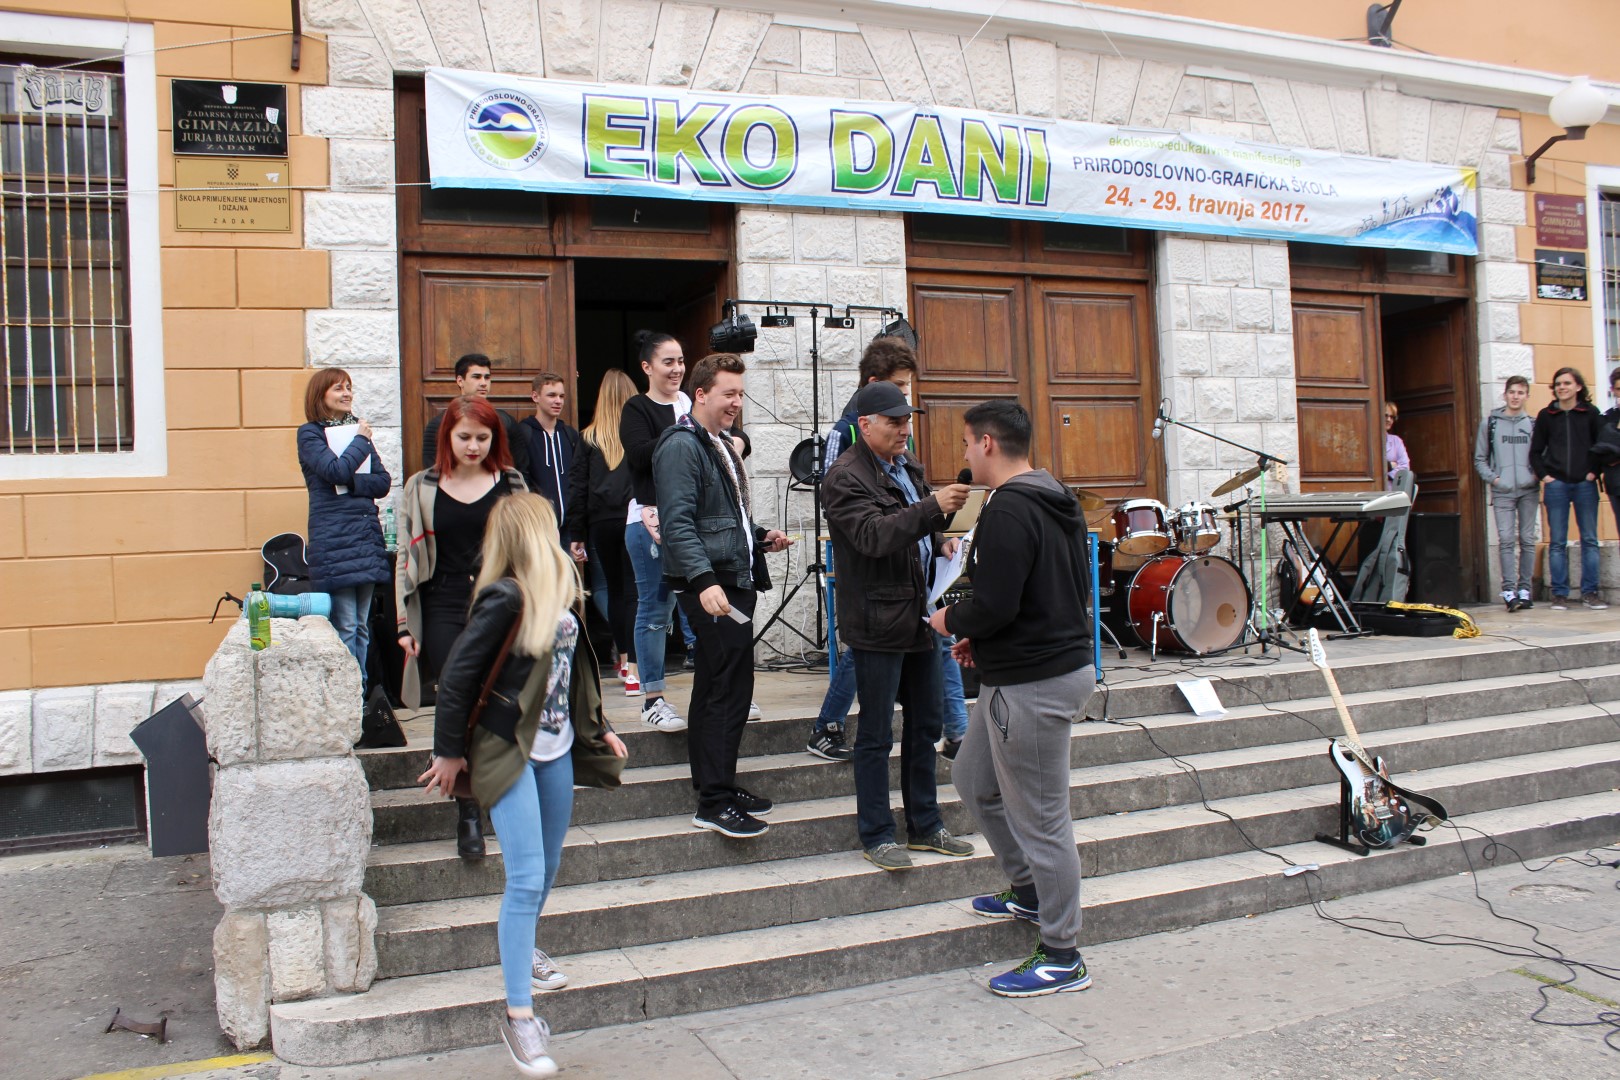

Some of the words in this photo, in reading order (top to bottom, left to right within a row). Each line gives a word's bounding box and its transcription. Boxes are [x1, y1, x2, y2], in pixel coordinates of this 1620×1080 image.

[187, 110, 231, 118] ZADARSKA
[178, 118, 282, 133] GIMNAZIJA
[182, 132, 212, 142] JURJA
[215, 133, 279, 144] BARAKOVIĆA
[582, 93, 799, 190] EKO
[829, 108, 1051, 206] DANI
[1232, 149, 1302, 168] manifestacija
[1072, 156, 1290, 192] PRIRODOSLOVNO-GRAFIČKA
[1291, 176, 1339, 197] ŠKOLA
[179, 193, 201, 202] ŠKOLA
[202, 195, 247, 203] PRIMIJENJENE
[248, 196, 287, 204] UMJETNOSTI
[1104, 184, 1133, 207] 24.
[1153, 190, 1181, 211] 29.
[1189, 193, 1255, 221] travnja
[1261, 201, 1309, 223] 2017.
[1502, 435, 1528, 445] PUMA
